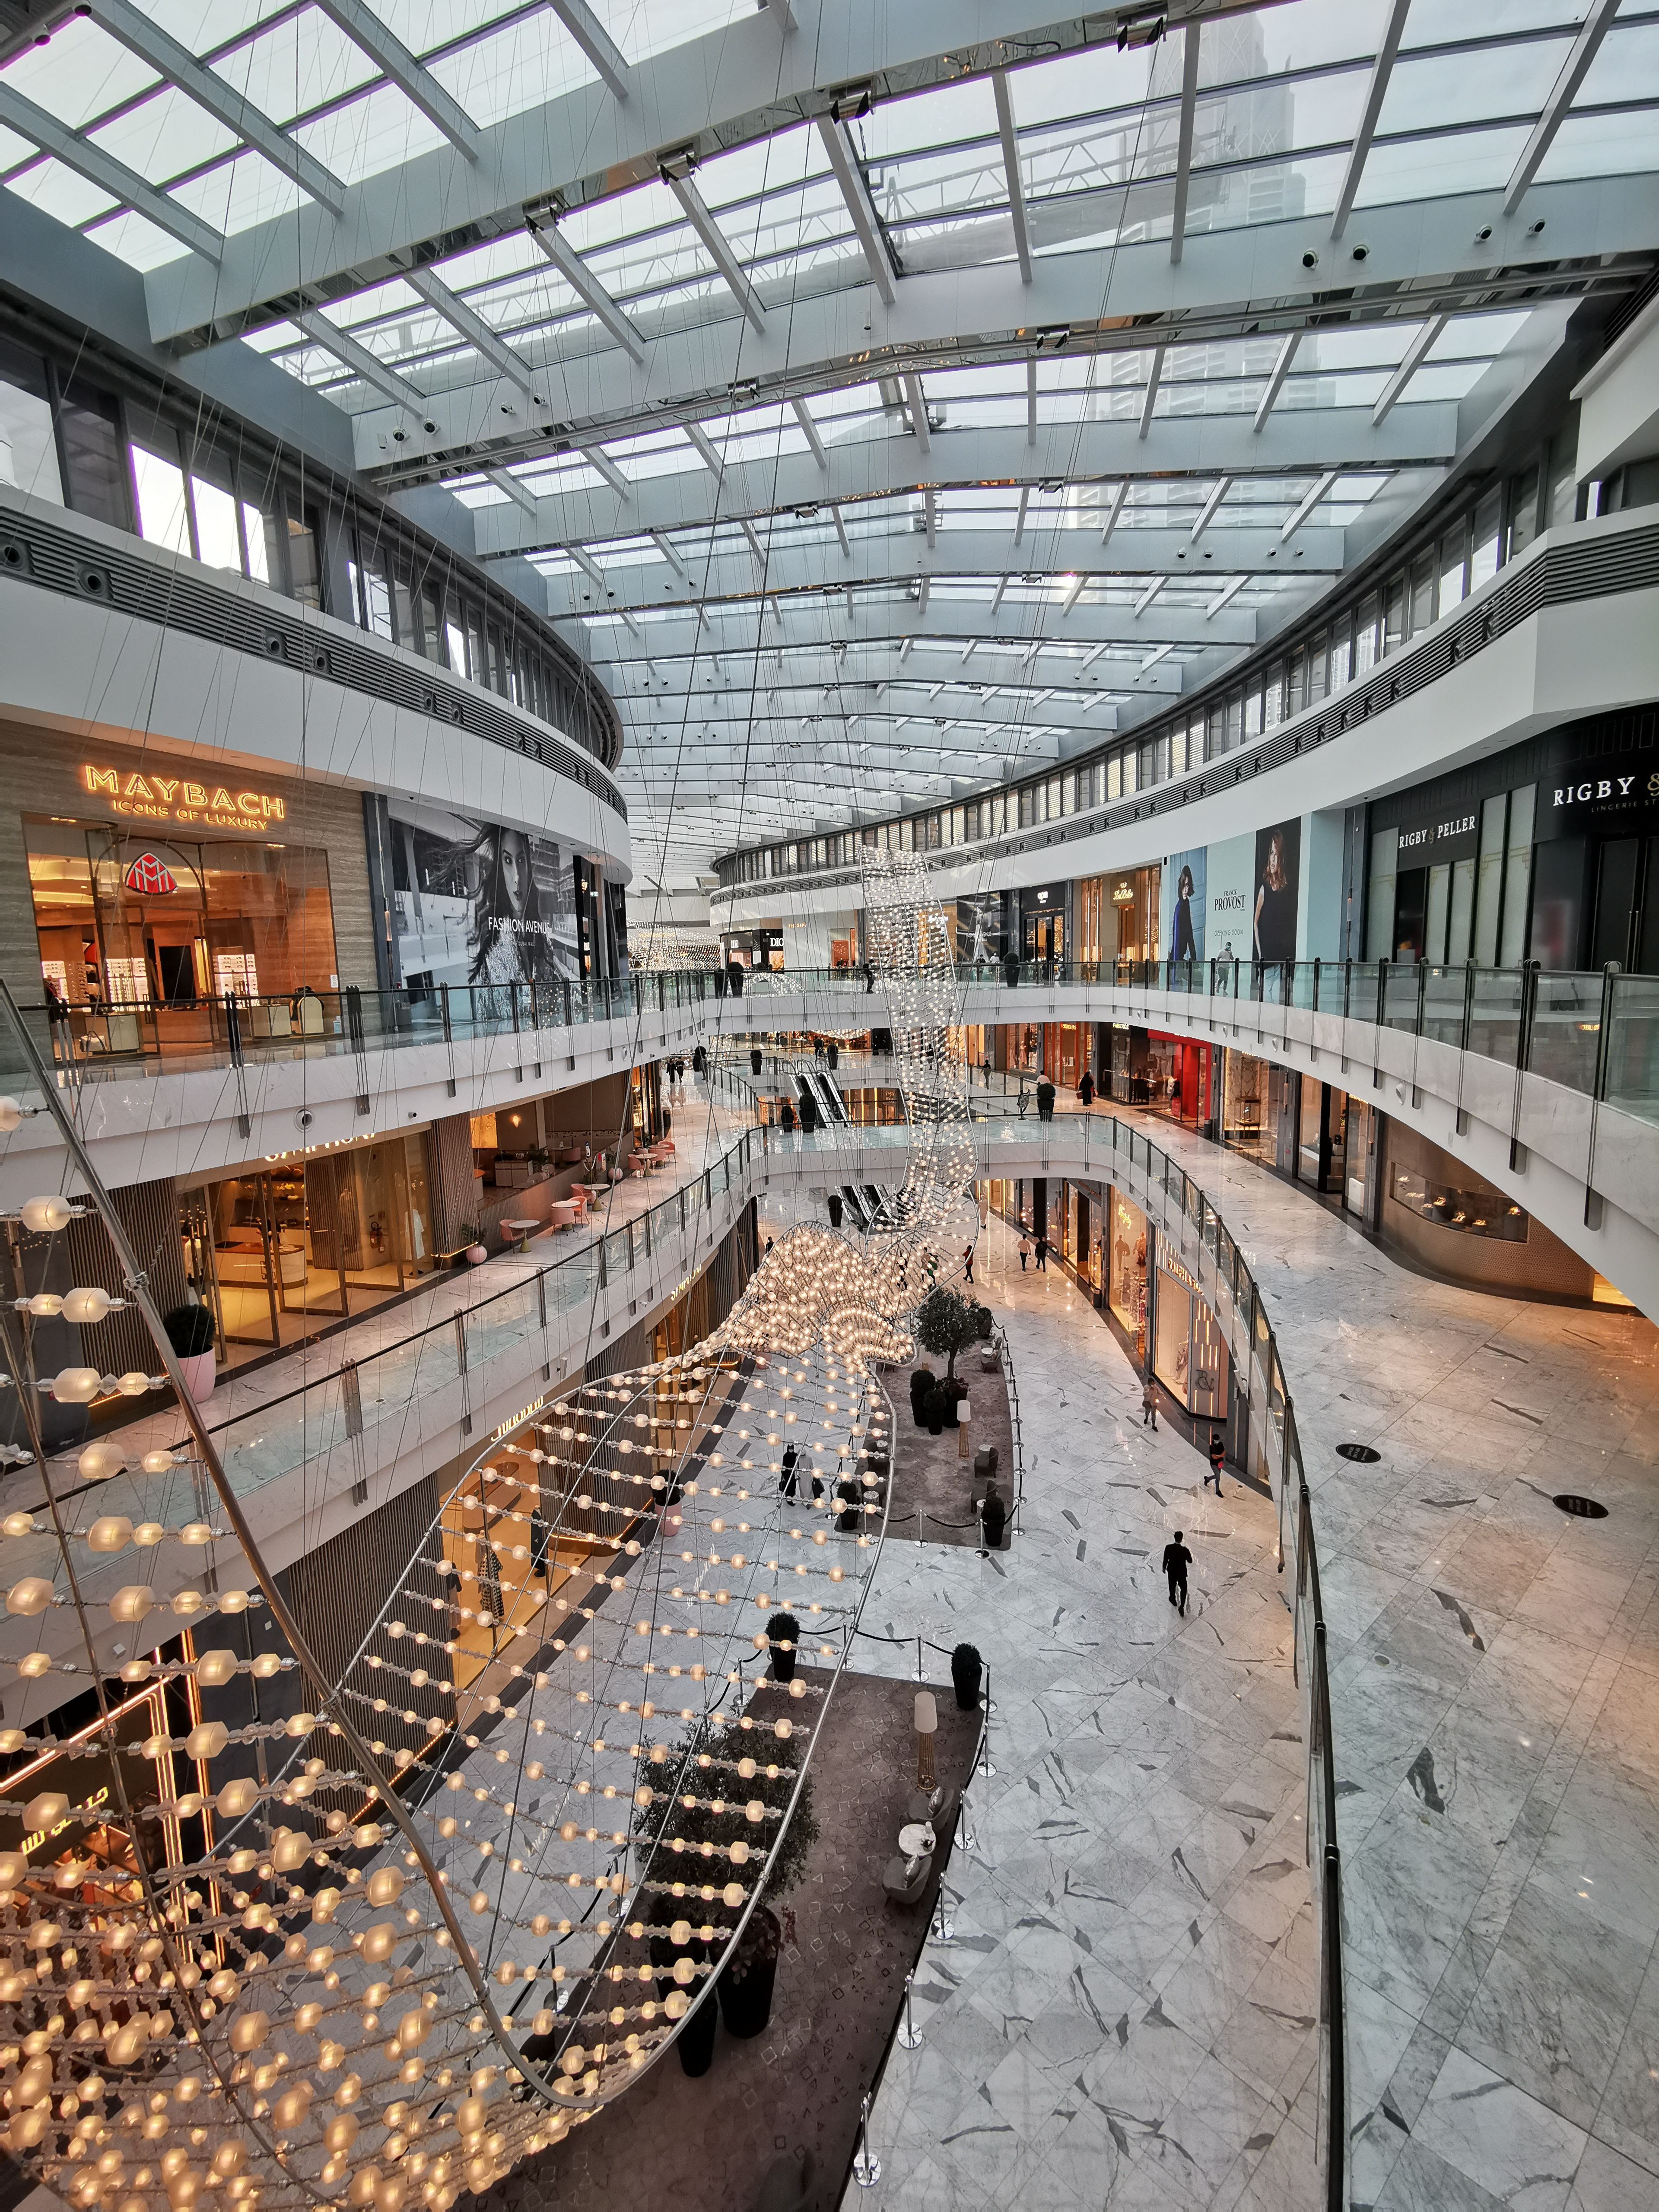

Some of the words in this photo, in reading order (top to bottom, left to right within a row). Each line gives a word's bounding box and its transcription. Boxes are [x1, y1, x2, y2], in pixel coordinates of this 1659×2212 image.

[86, 765, 285, 818] MAYBACH
[1553, 776, 1635, 806] RIGBY
[1647, 773, 1659, 796] &
[113, 799, 169, 816] ICONS
[177, 809, 200, 820] OF
[206, 813, 268, 830] LUXURY
[1592, 801, 1638, 813] LINGERIE
[1399, 829, 1428, 848] RIGBY
[1429, 827, 1437, 845] &
[1437, 816, 1476, 839] PELLER
[1214, 895, 1246, 911] PROVOST
[488, 917, 524, 933] FASHION
[525, 920, 550, 934] AVENUE
